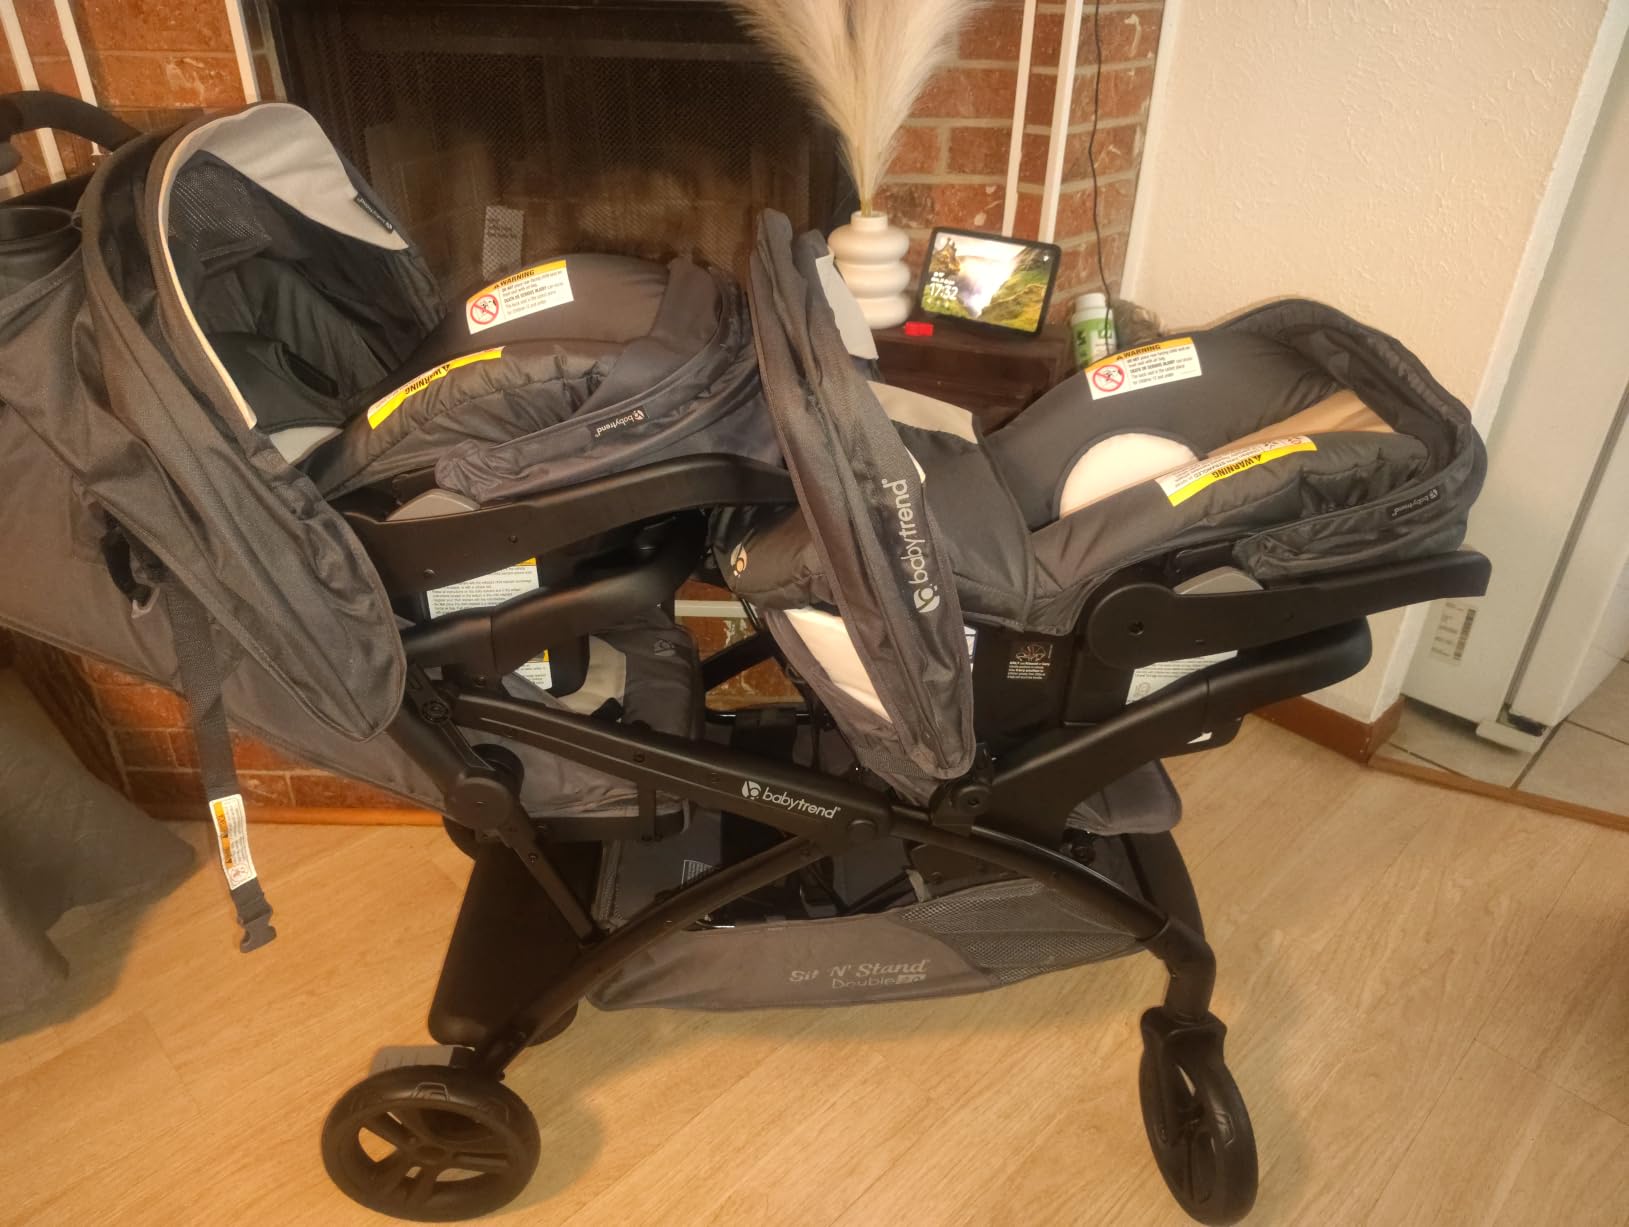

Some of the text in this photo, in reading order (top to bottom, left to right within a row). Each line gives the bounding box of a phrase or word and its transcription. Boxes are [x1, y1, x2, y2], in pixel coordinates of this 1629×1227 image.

[500, 269, 535, 287] WARNING
[929, 282, 959, 300] 17:32
[1123, 344, 1161, 359] WARNING
[596, 414, 635, 437] babytrend
[1211, 456, 1255, 479] WARNING
[882, 479, 929, 584] babytrend
[762, 786, 838, 819] babytrend
[856, 959, 926, 977] Stand
